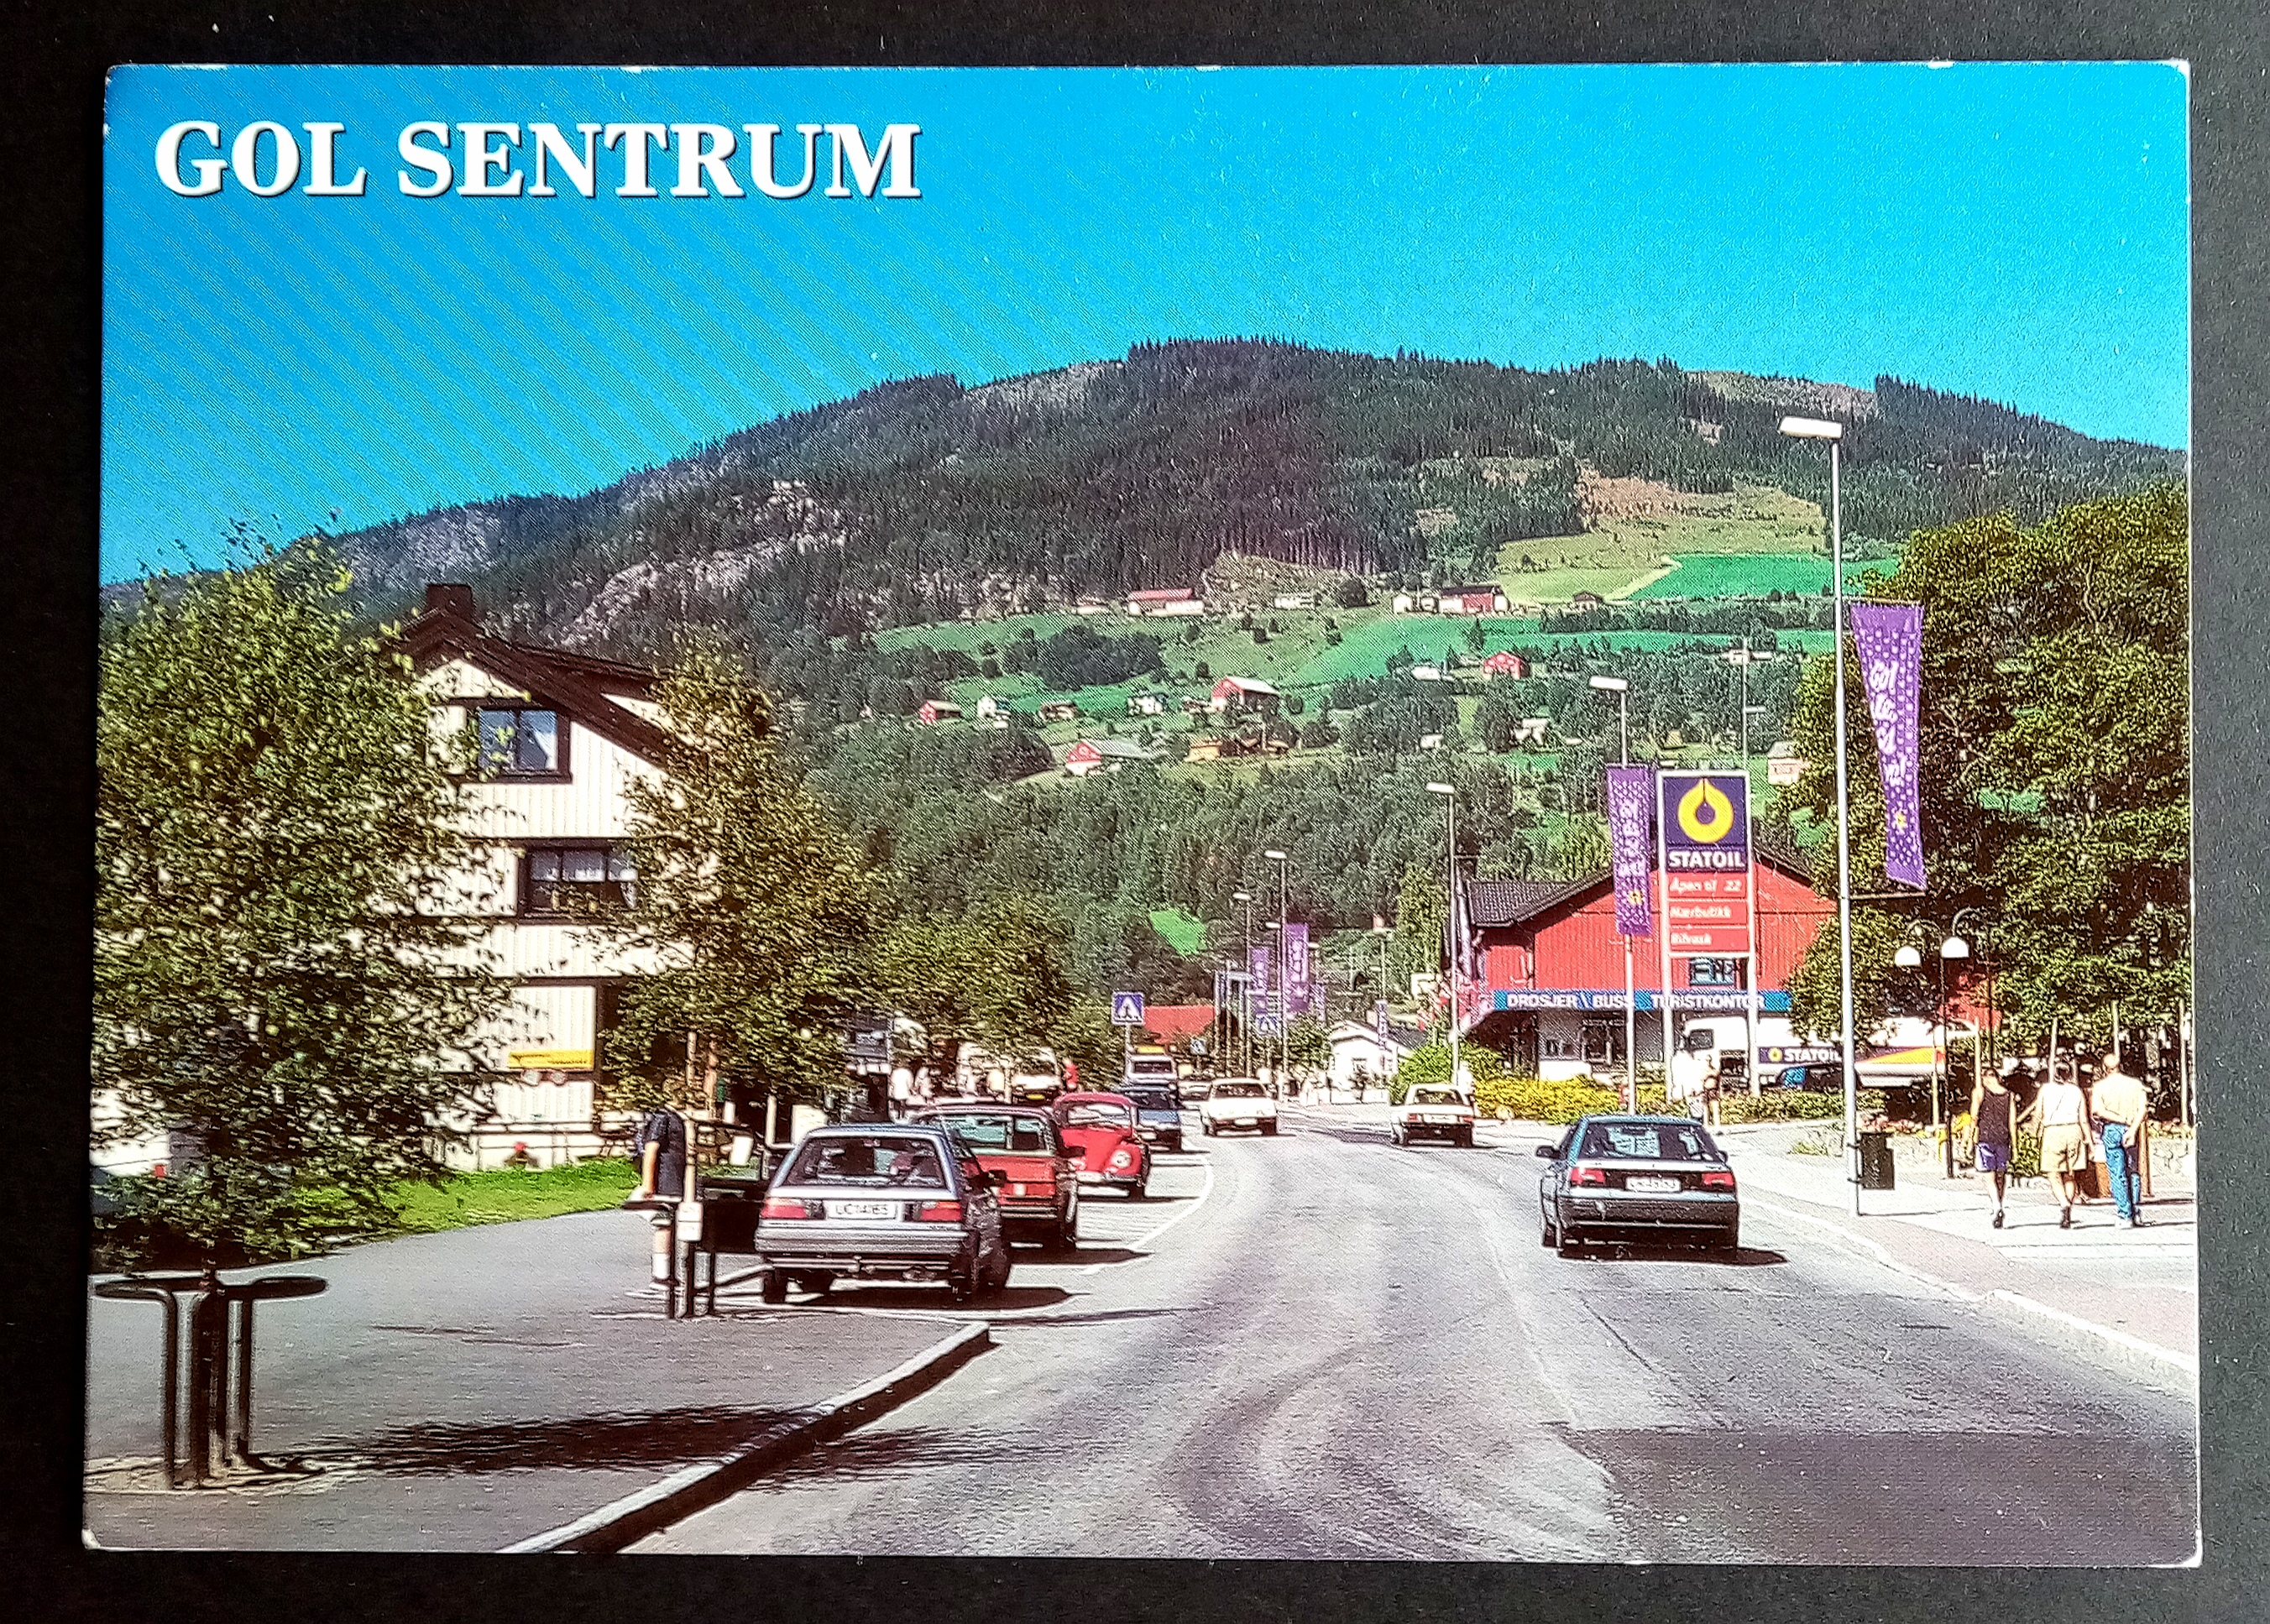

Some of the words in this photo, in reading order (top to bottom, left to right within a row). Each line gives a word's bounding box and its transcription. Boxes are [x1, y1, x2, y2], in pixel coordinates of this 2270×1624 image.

[1668, 850, 1746, 869] STATOIL
[1507, 994, 1578, 1008] DROSJER
[1784, 1048, 1843, 1063] STATOIL
